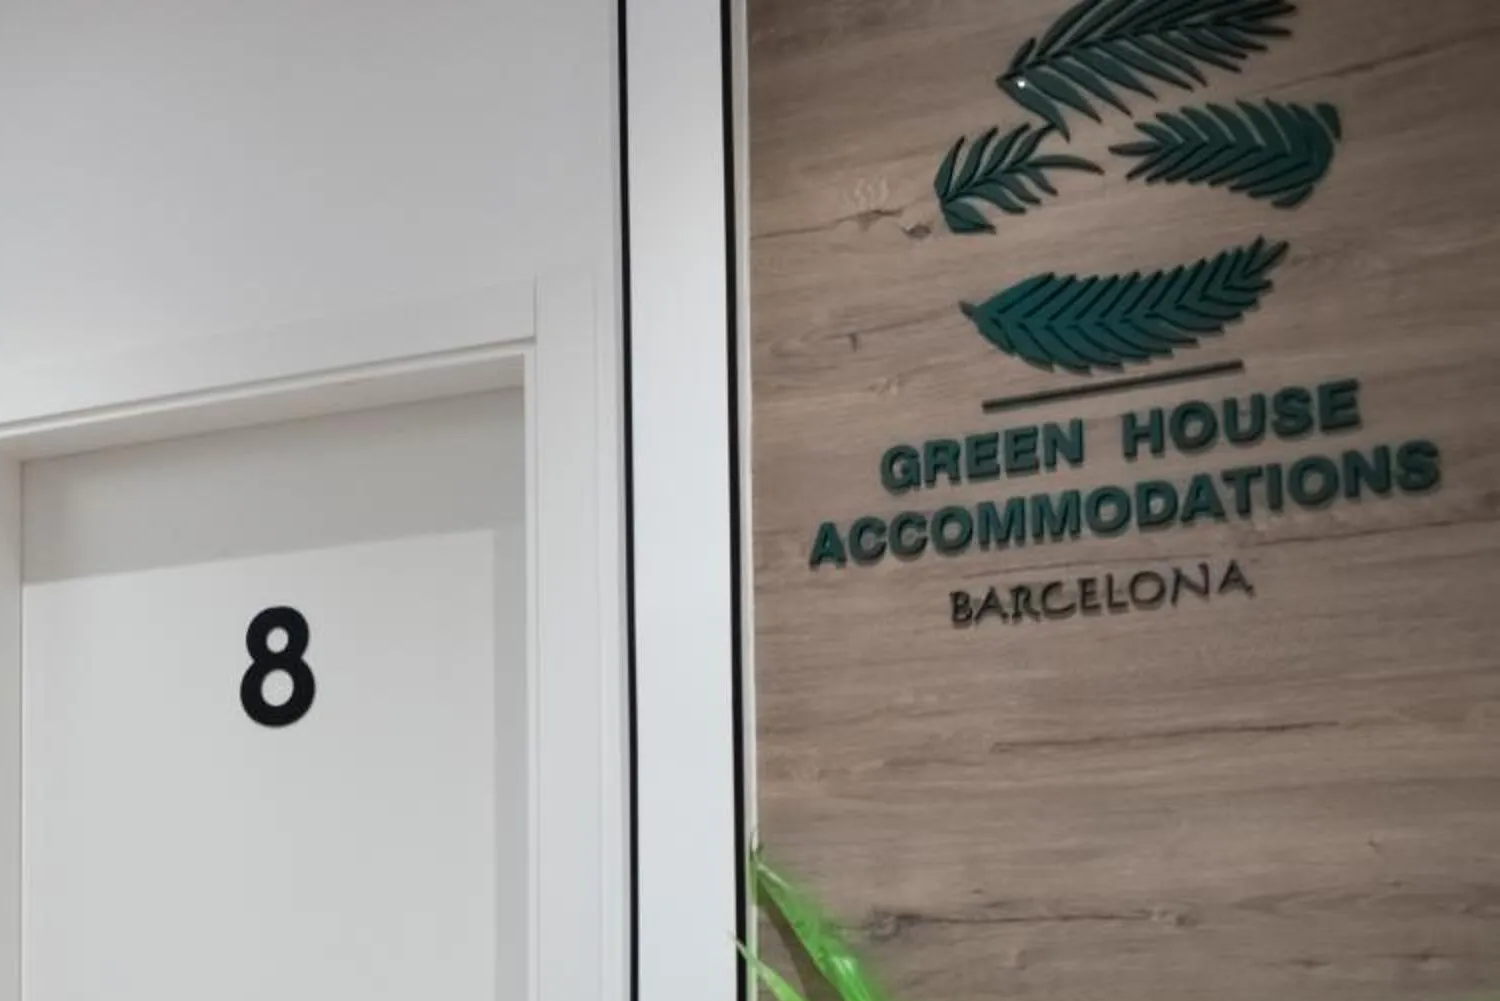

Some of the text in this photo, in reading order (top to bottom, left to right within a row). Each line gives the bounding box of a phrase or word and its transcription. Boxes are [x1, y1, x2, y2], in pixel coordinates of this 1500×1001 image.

[880, 377, 1362, 495] GREEN HOUSE
[808, 440, 1442, 572] ACCOMMODATIONS
[949, 559, 1255, 628] BARCELONA
[240, 606, 316, 728] 8
